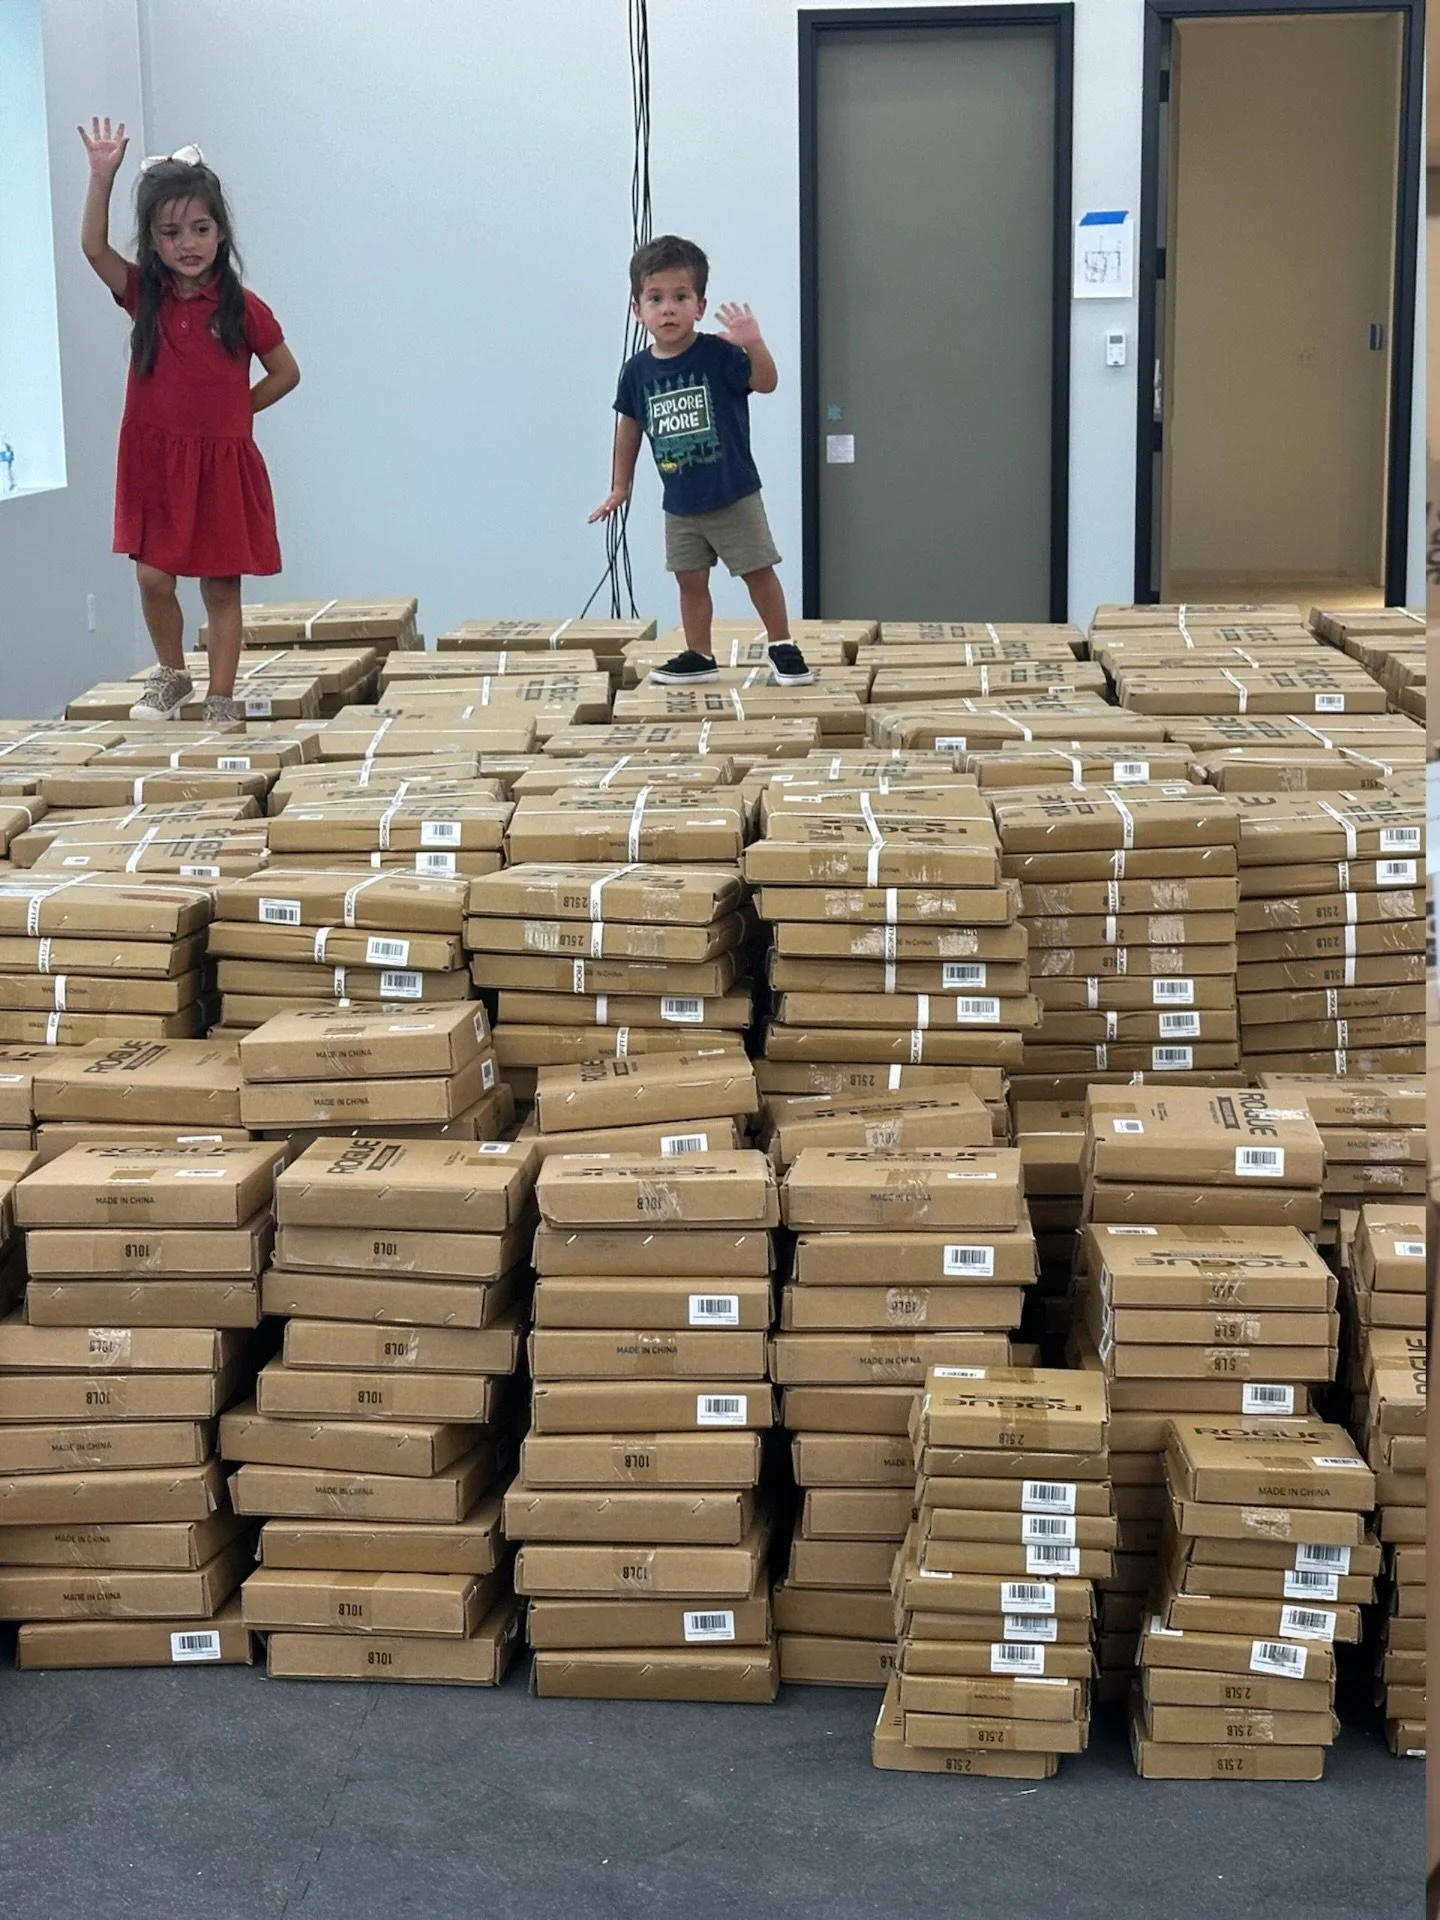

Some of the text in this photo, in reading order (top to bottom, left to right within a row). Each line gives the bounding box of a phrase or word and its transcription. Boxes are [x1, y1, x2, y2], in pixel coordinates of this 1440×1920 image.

[653, 394, 704, 419] EXPLORE
[658, 411, 700, 435] MORE
[83, 1040, 152, 1074] ROGUE
[1238, 1092, 1278, 1137] ROGUE
[327, 1140, 382, 1174] ROGUE
[126, 1244, 149, 1257] 10LB
[373, 1242, 397, 1255] 10LB
[1132, 1257, 1309, 1268] ROGUE
[384, 1342, 408, 1356] 10LB
[617, 1346, 639, 1354] MADE
[652, 1346, 678, 1354] CHINA
[1214, 1358, 1236, 1371] 5LB
[86, 1391, 110, 1404] 10LB
[358, 1391, 382, 1404] 10LB
[940, 1398, 1082, 1412] ROGUE
[1194, 1427, 1334, 1440] ROGUE
[625, 1455, 650, 1468] 10LB
[1258, 1487, 1286, 1496] MADE
[1300, 1488, 1330, 1497] CHINA
[339, 1603, 363, 1617] 10LB
[368, 1652, 392, 1665] 10LB
[1225, 1687, 1251, 1699] 2.5LB
